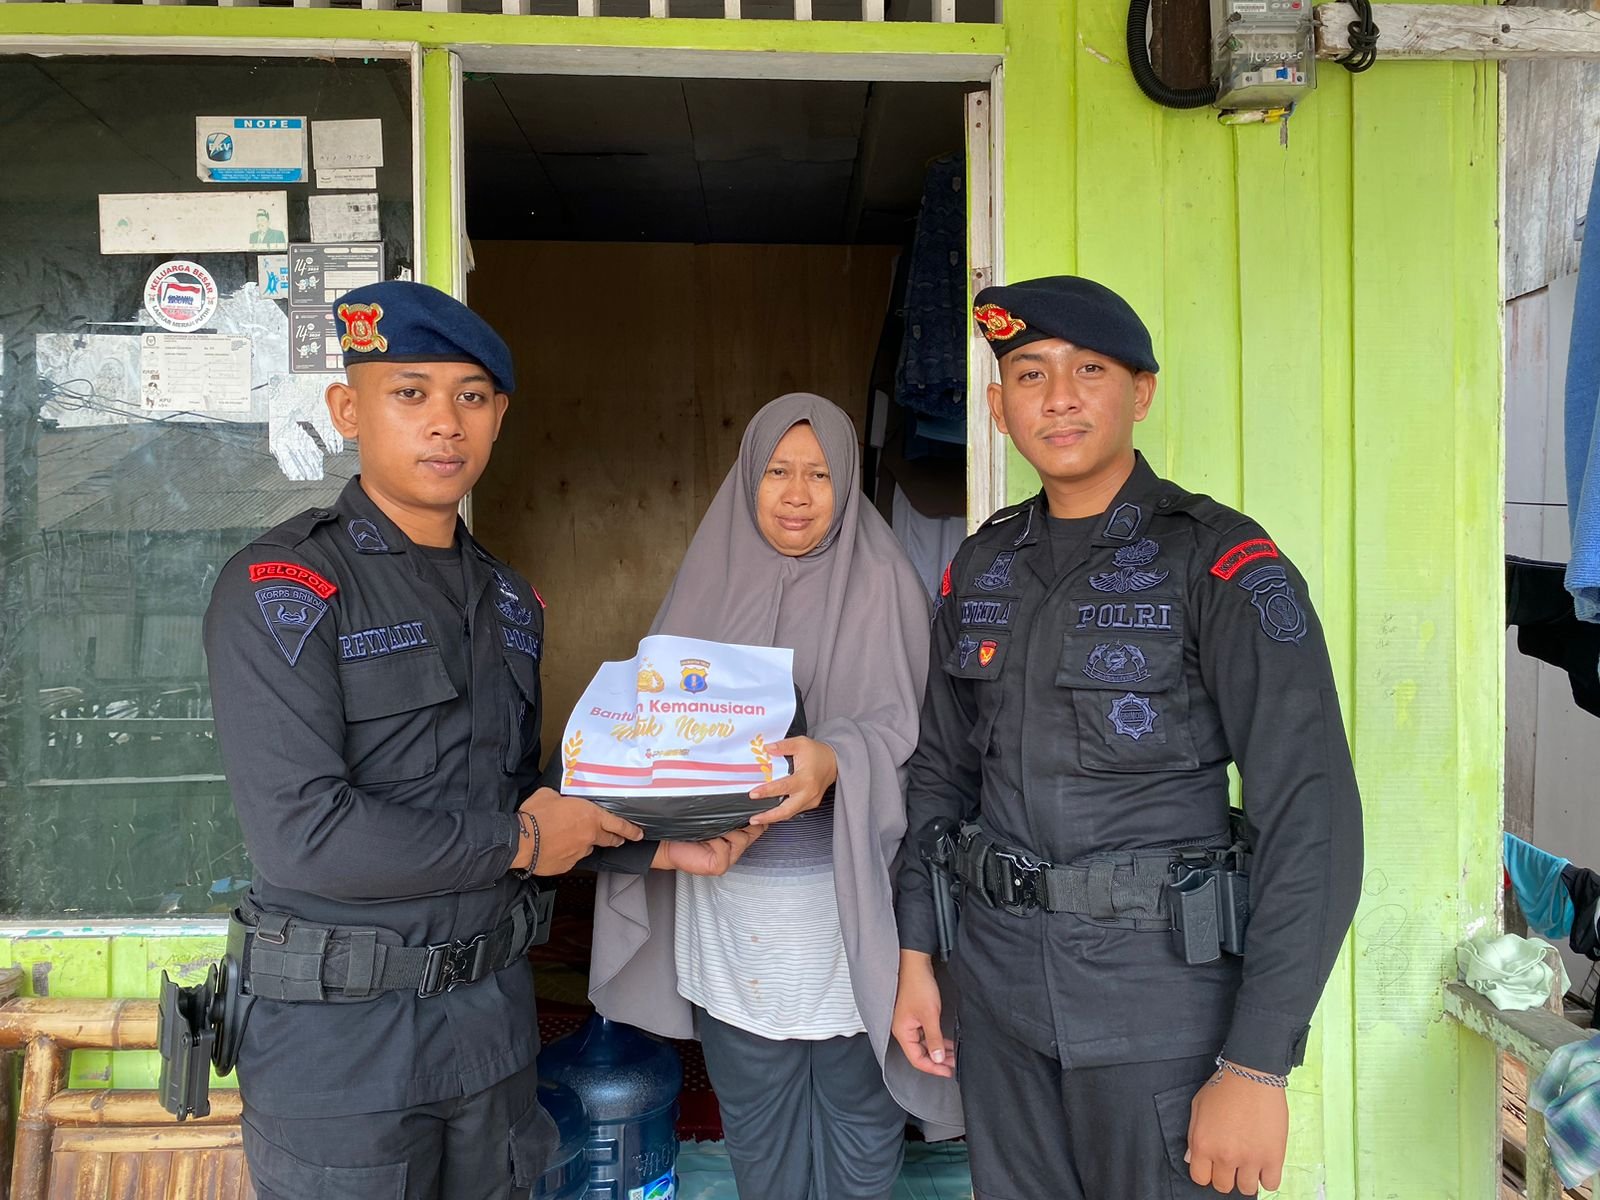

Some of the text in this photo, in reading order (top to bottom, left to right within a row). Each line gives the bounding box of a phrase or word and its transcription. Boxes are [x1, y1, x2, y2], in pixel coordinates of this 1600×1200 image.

[243, 119, 289, 128] NOPE
[150, 265, 213, 294] KELUARGA BESAR
[256, 565, 329, 593] PELOPOR
[260, 589, 324, 610] KORPS BRIMOB
[1075, 603, 1172, 630] POLRI
[338, 622, 428, 659] REYNALDY
[649, 699, 766, 716] Kemanusiaan
[674, 714, 736, 744] Negeri
